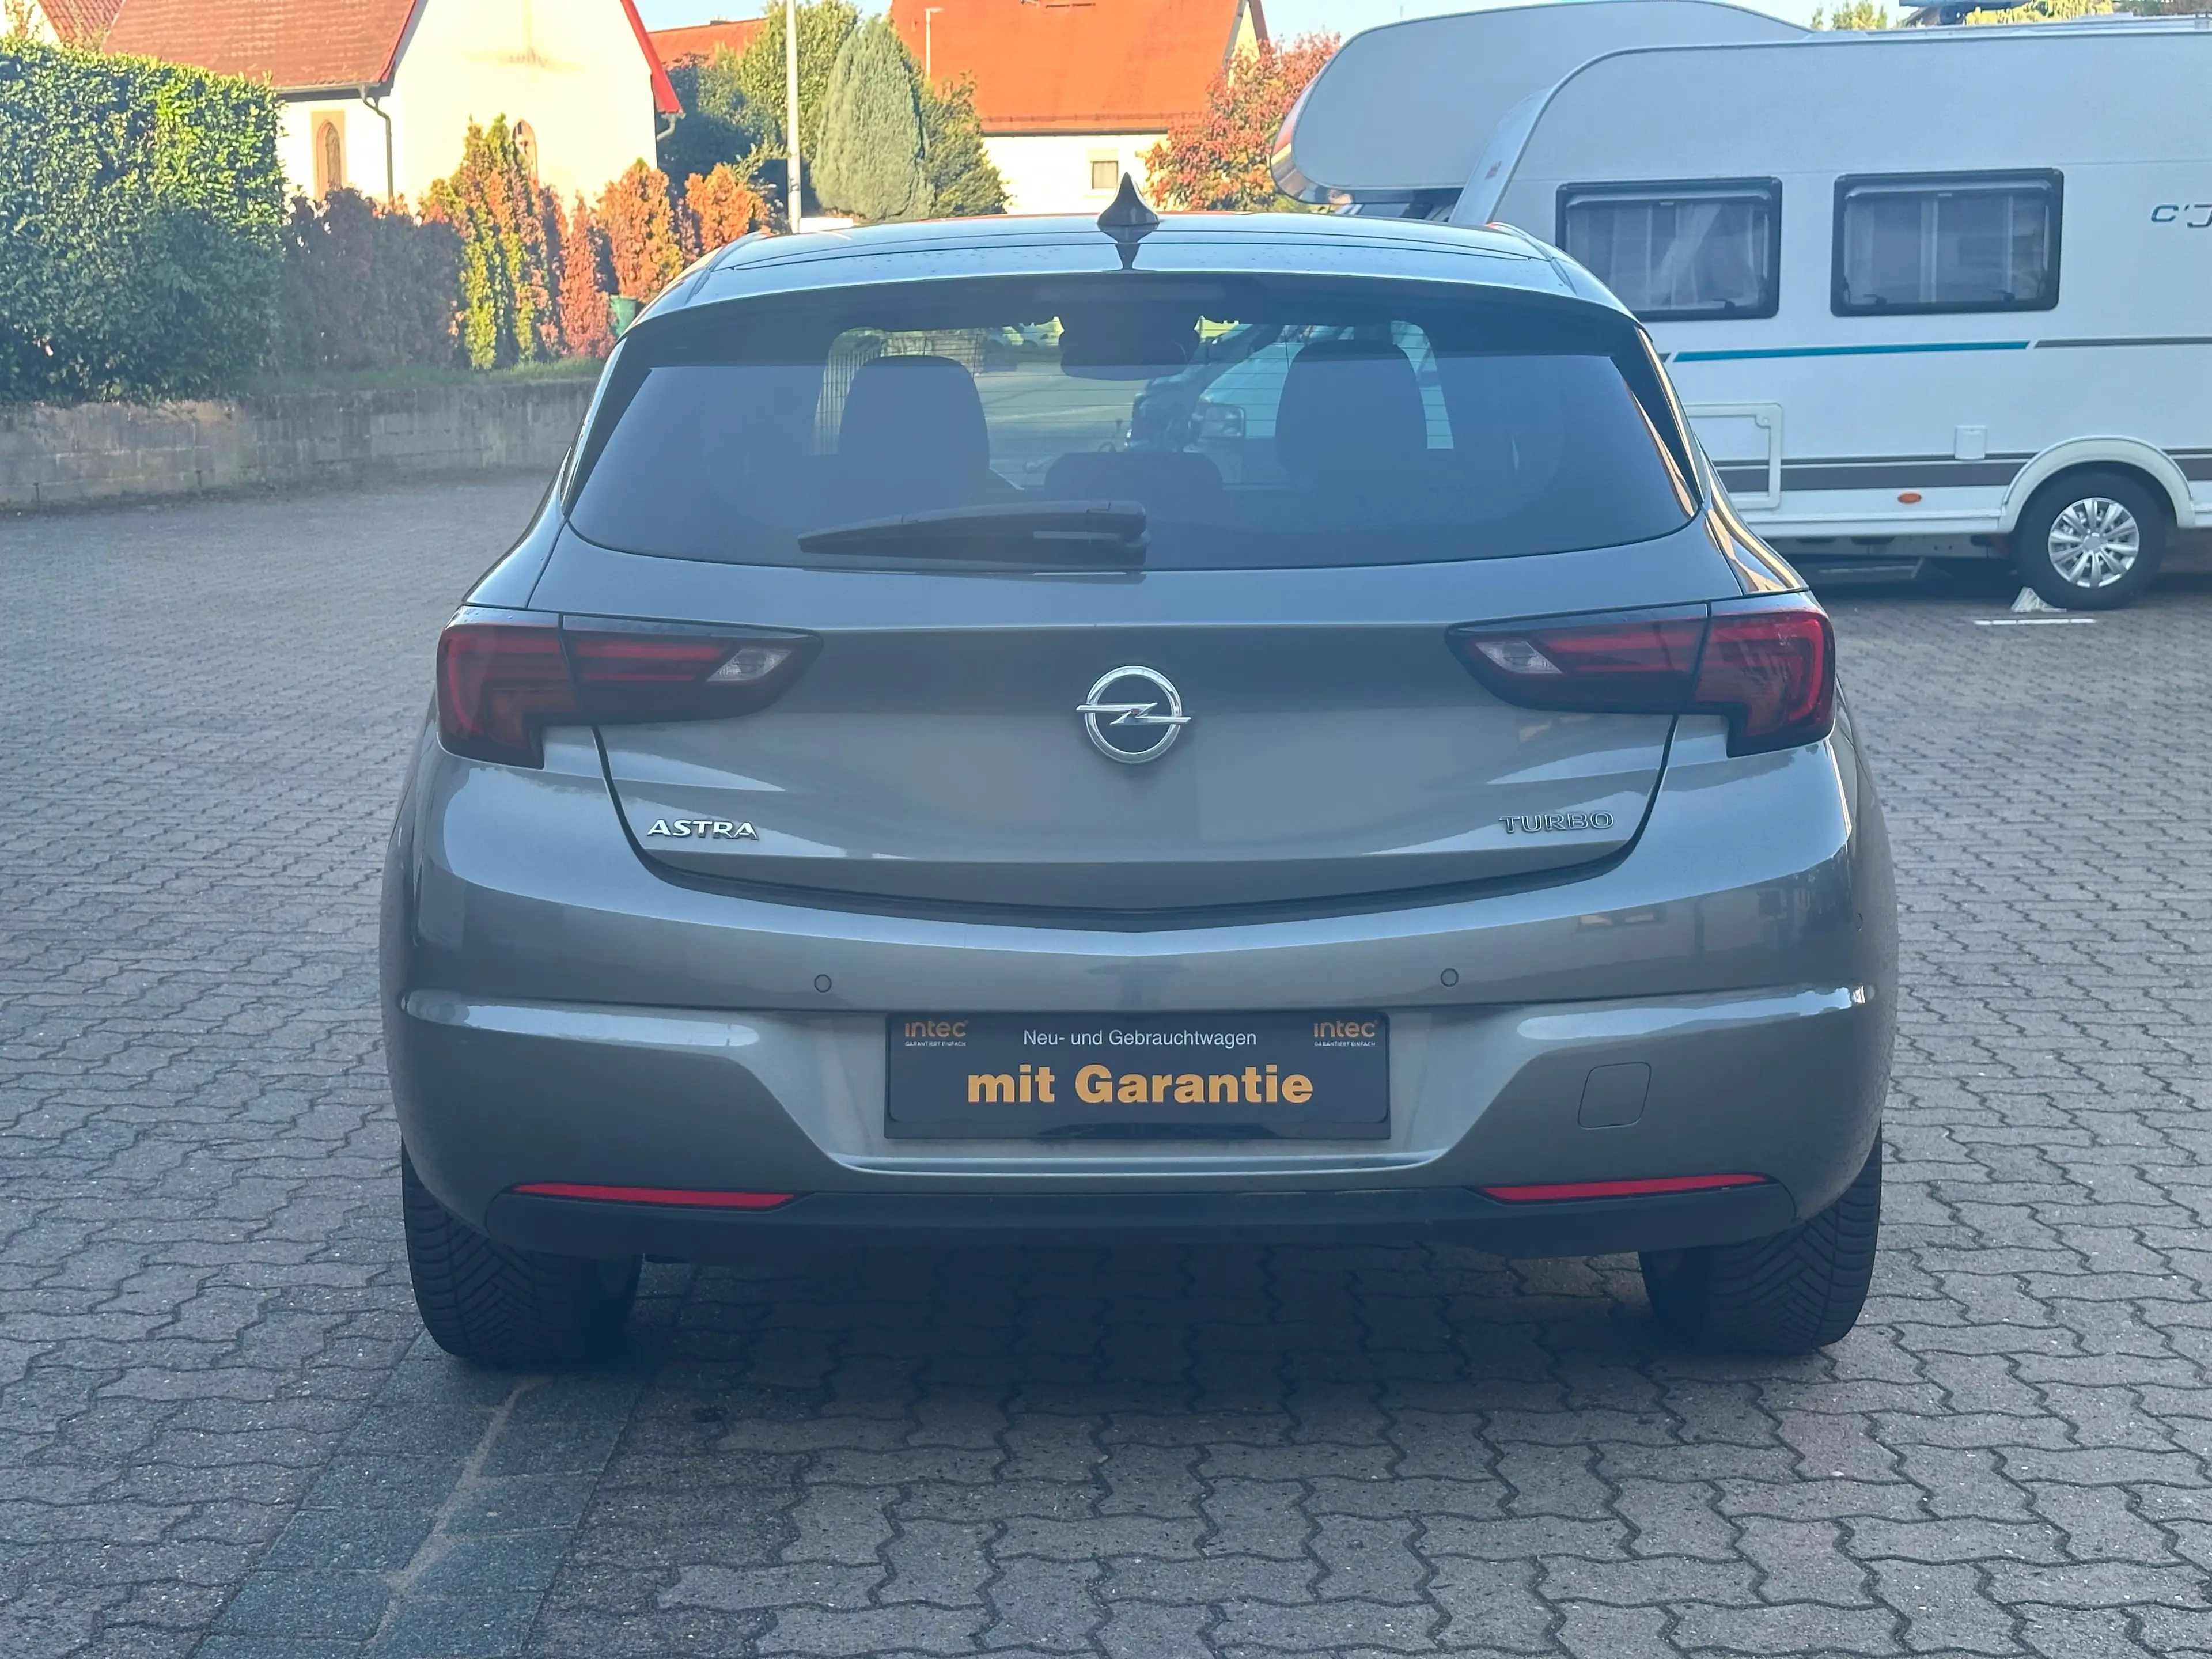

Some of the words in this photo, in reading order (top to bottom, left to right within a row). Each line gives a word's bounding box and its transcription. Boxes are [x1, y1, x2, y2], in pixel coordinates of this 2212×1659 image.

[647, 819, 759, 840] ASTRA
[1499, 811, 1613, 834] TURBO
[904, 1020, 967, 1037] intec
[1313, 1020, 1376, 1037] intec
[1023, 1030, 1065, 1045] Neu-
[1071, 1030, 1103, 1045] und
[1109, 1030, 1256, 1049] Gebrauchtwagen
[968, 1064, 1055, 1103] mit
[1075, 1064, 1313, 1103] Garantie
